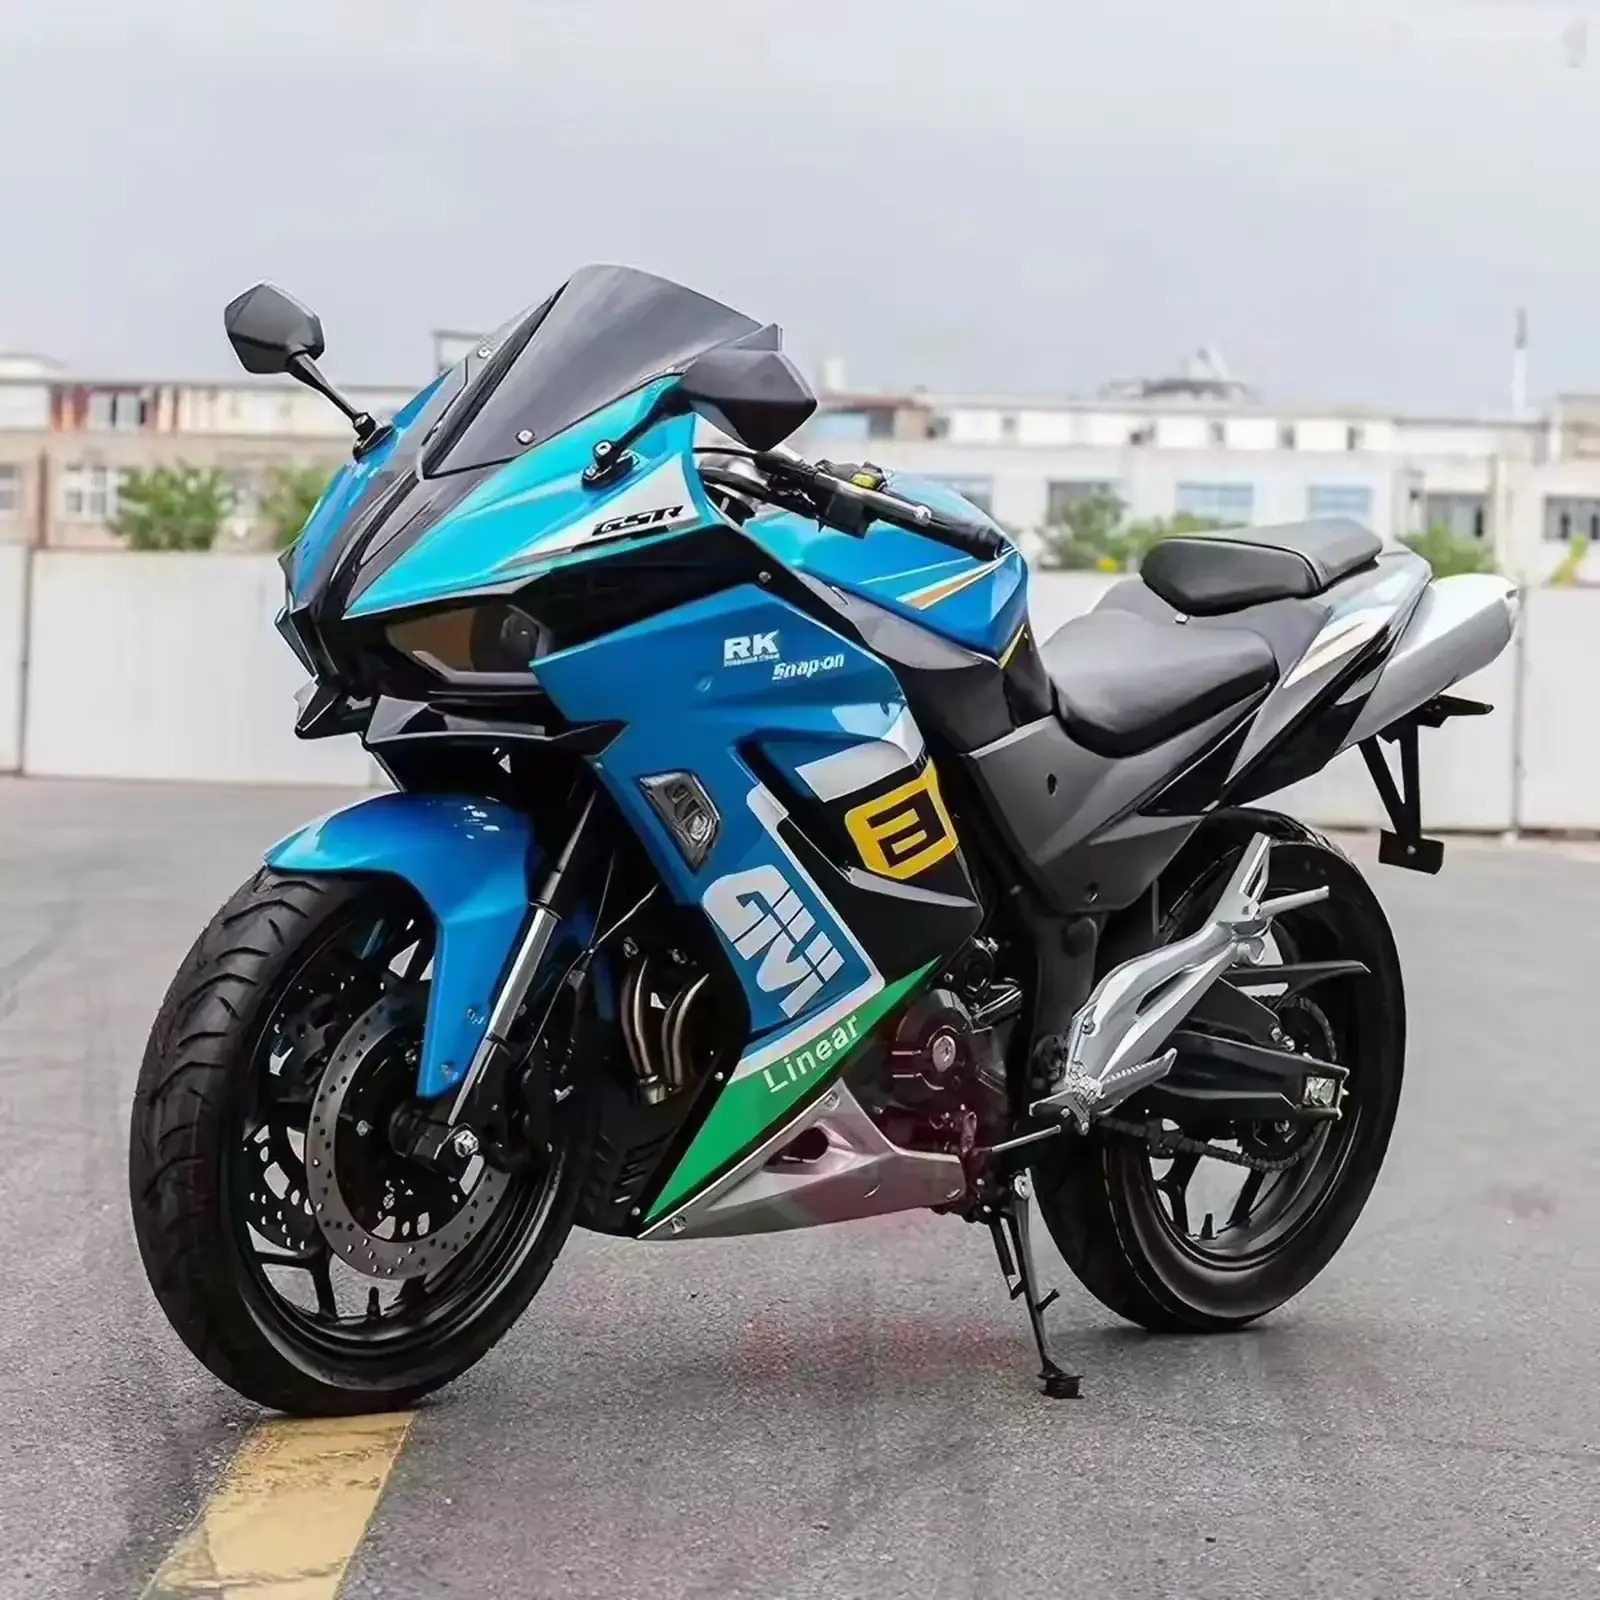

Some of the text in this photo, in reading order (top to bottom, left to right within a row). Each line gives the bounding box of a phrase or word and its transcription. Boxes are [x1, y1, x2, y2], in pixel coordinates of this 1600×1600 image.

[592, 505, 684, 536] GSR
[723, 629, 779, 661] RK
[763, 1015, 861, 1093] Linear
